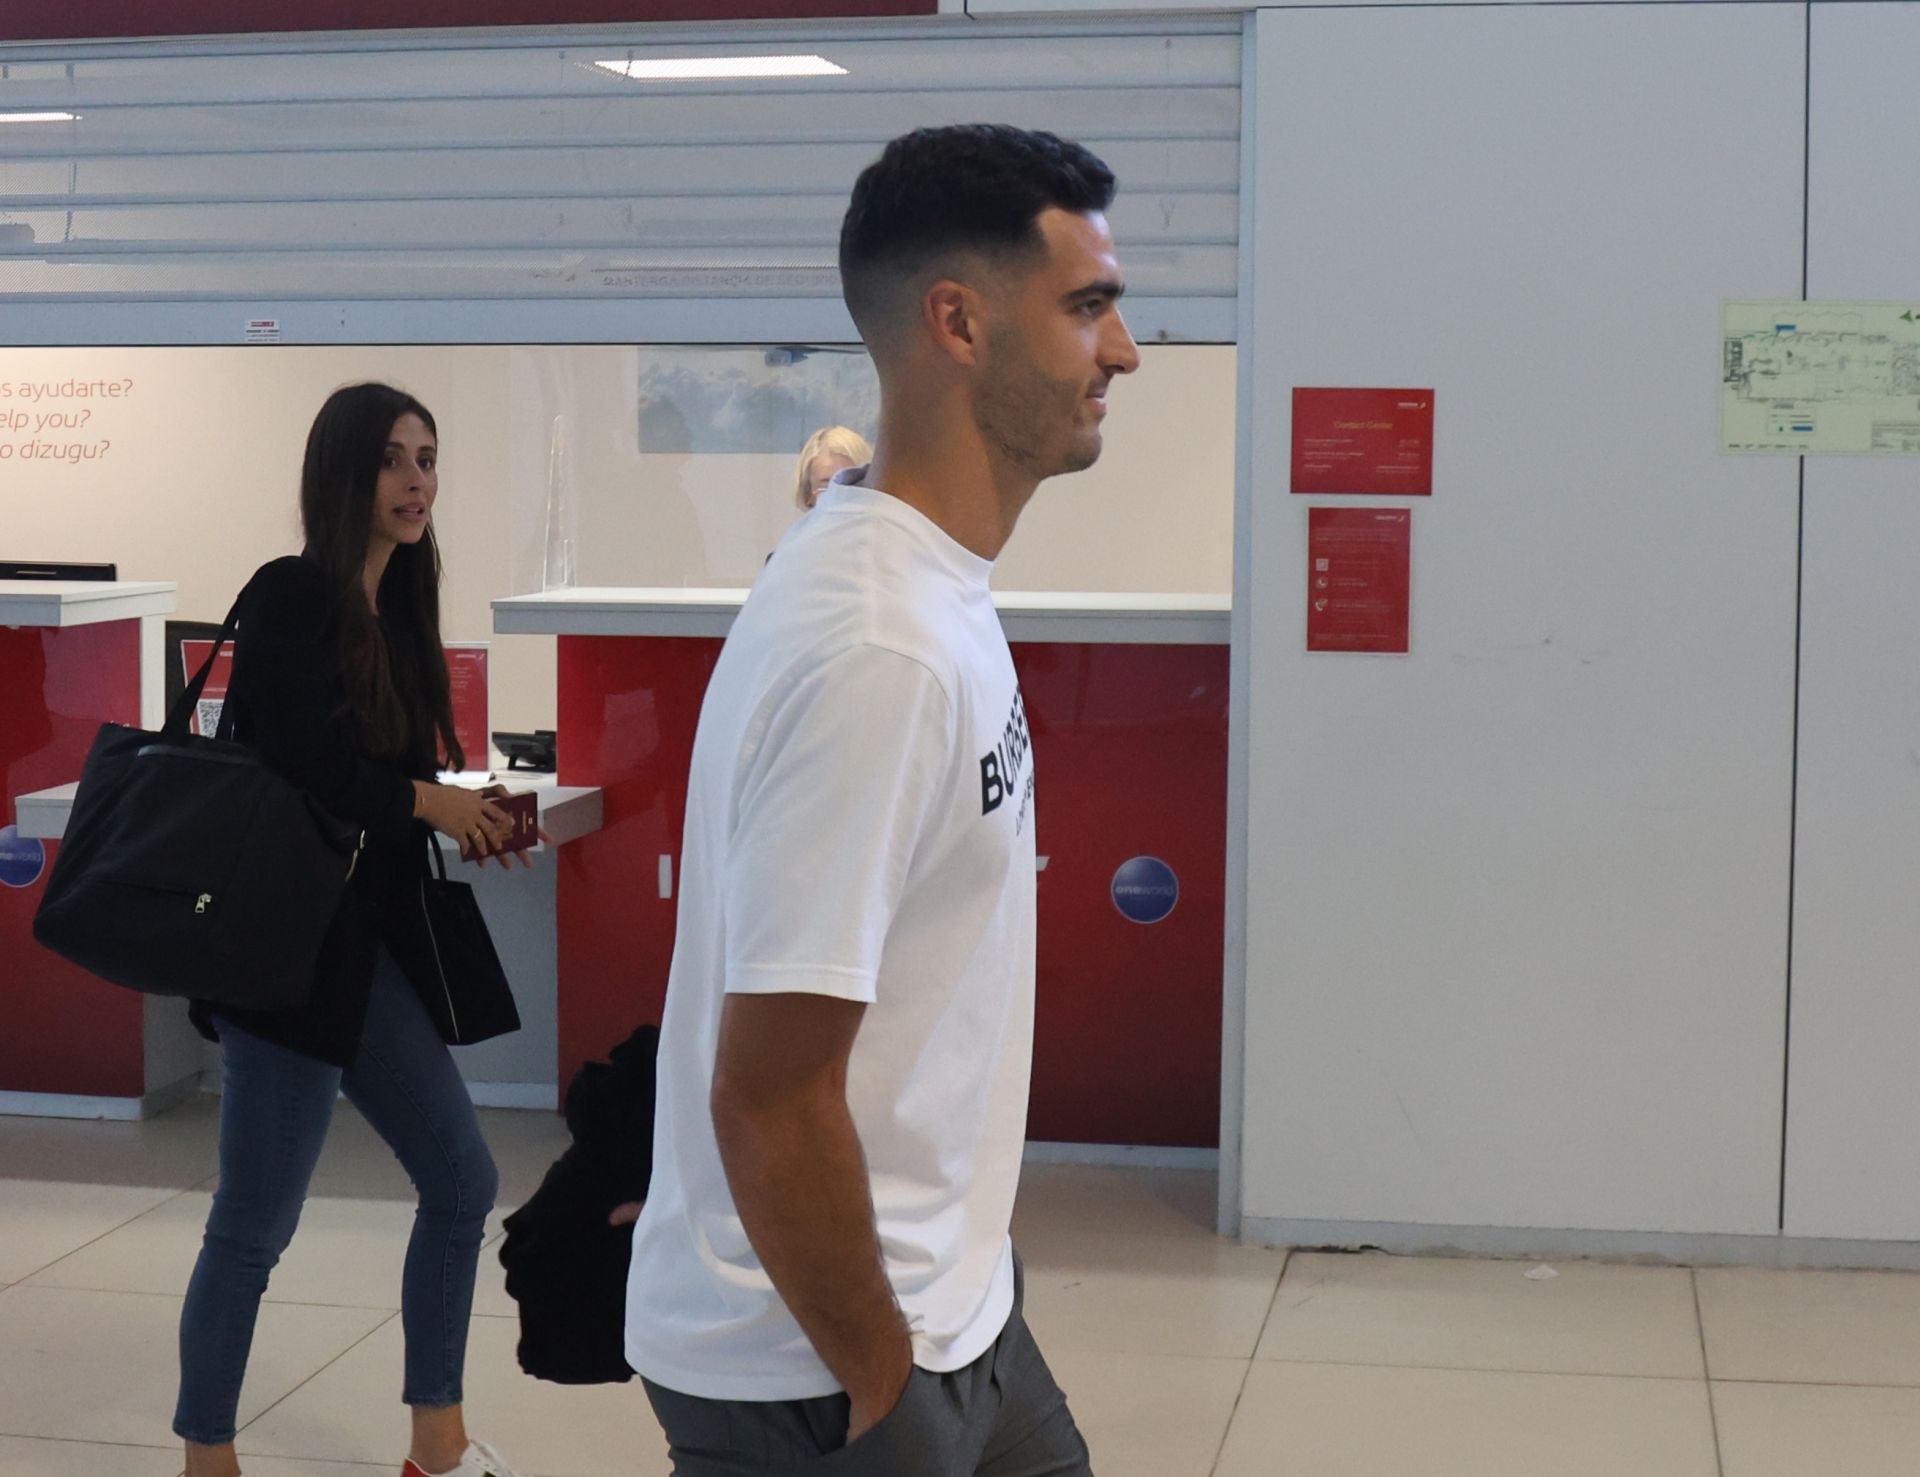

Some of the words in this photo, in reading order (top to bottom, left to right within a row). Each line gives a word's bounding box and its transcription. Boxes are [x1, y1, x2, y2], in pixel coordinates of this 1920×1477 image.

[18, 378, 134, 403] ayudarte?
[35, 408, 91, 434] you?
[19, 439, 110, 465] dizugu?
